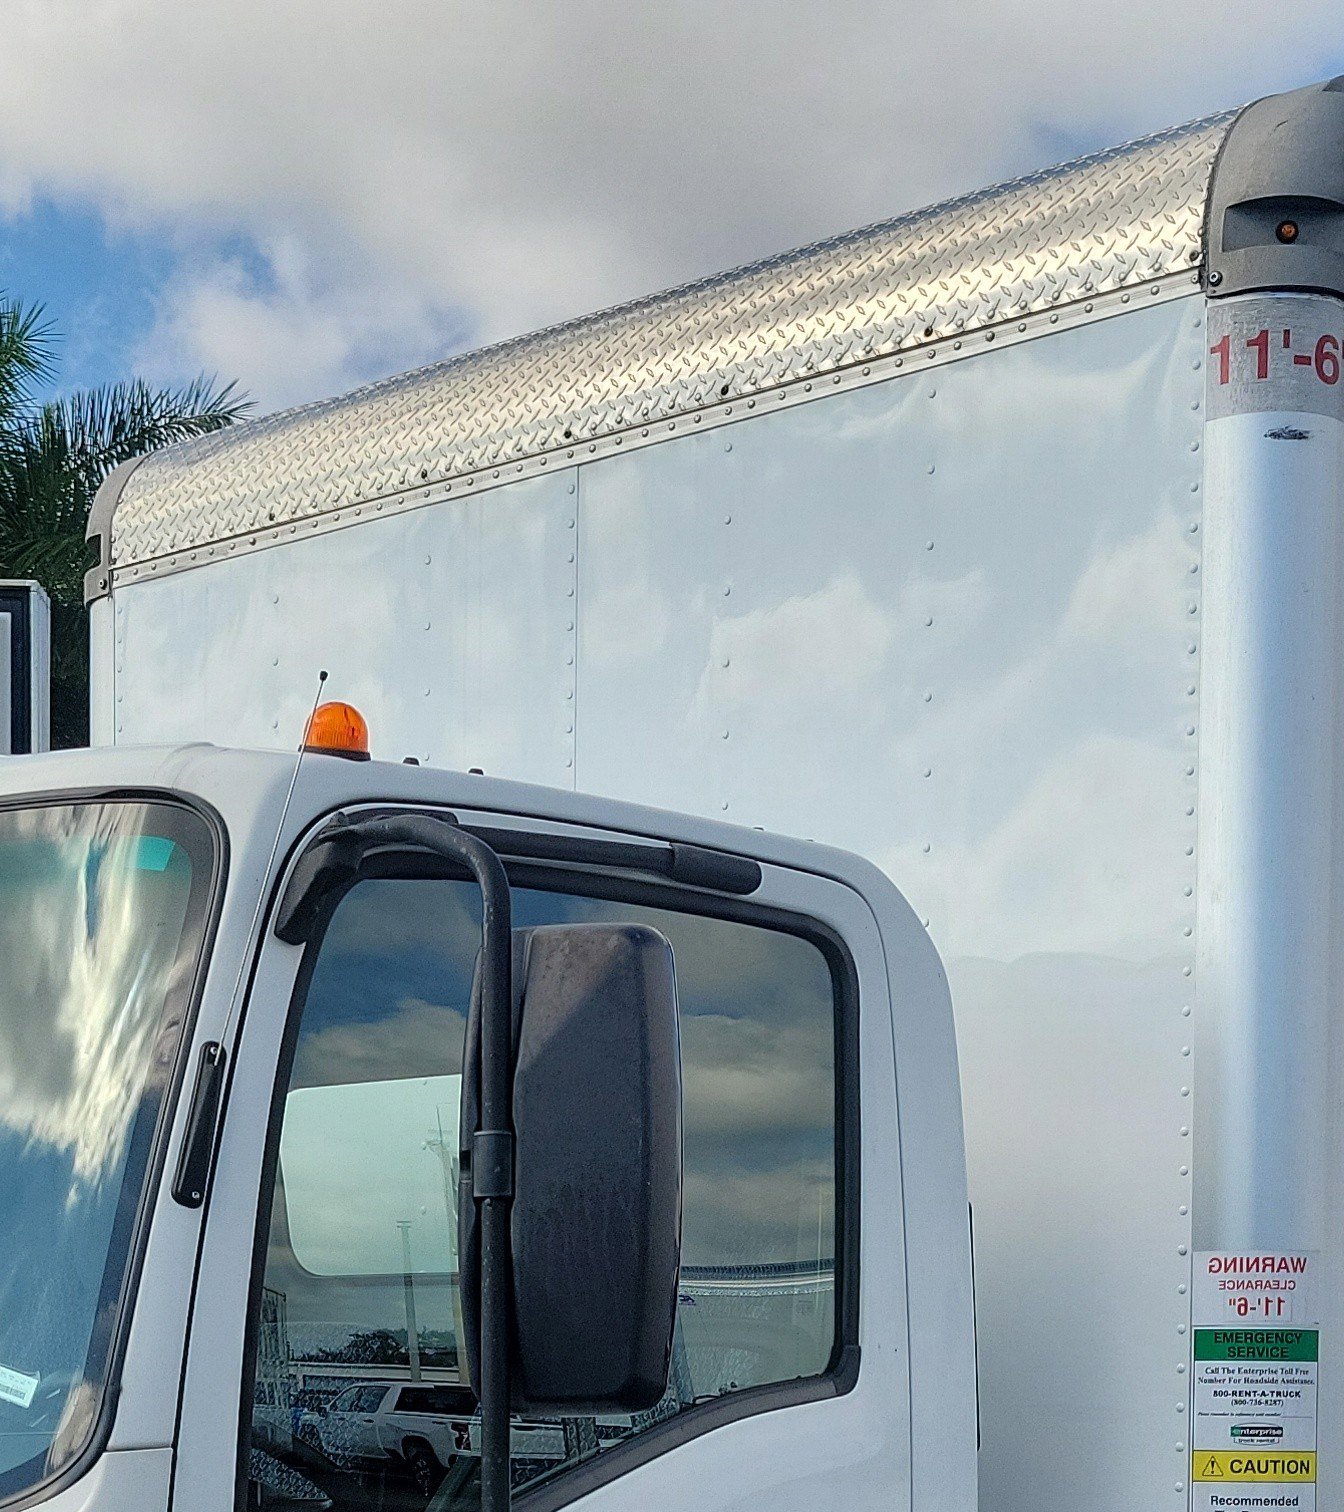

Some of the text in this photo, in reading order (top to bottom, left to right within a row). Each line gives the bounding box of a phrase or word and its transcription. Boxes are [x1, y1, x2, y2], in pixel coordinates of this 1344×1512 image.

[1213, 1332, 1303, 1344] EMERGENCY
[1227, 1346, 1290, 1358] SERVICE
[1205, 1367, 1219, 1375] Call
[1222, 1367, 1236, 1375] The
[1237, 1367, 1278, 1377] Enterprise
[1280, 1367, 1293, 1375] Toll
[1198, 1377, 1227, 1385] Number
[1243, 1377, 1279, 1385] Roadside
[1212, 1390, 1301, 1398] 800-RENT-A-TRUCK
[1232, 1428, 1283, 1437] enterprise
[1229, 1459, 1310, 1474] CAUTION
[1210, 1495, 1299, 1507] Recommended
